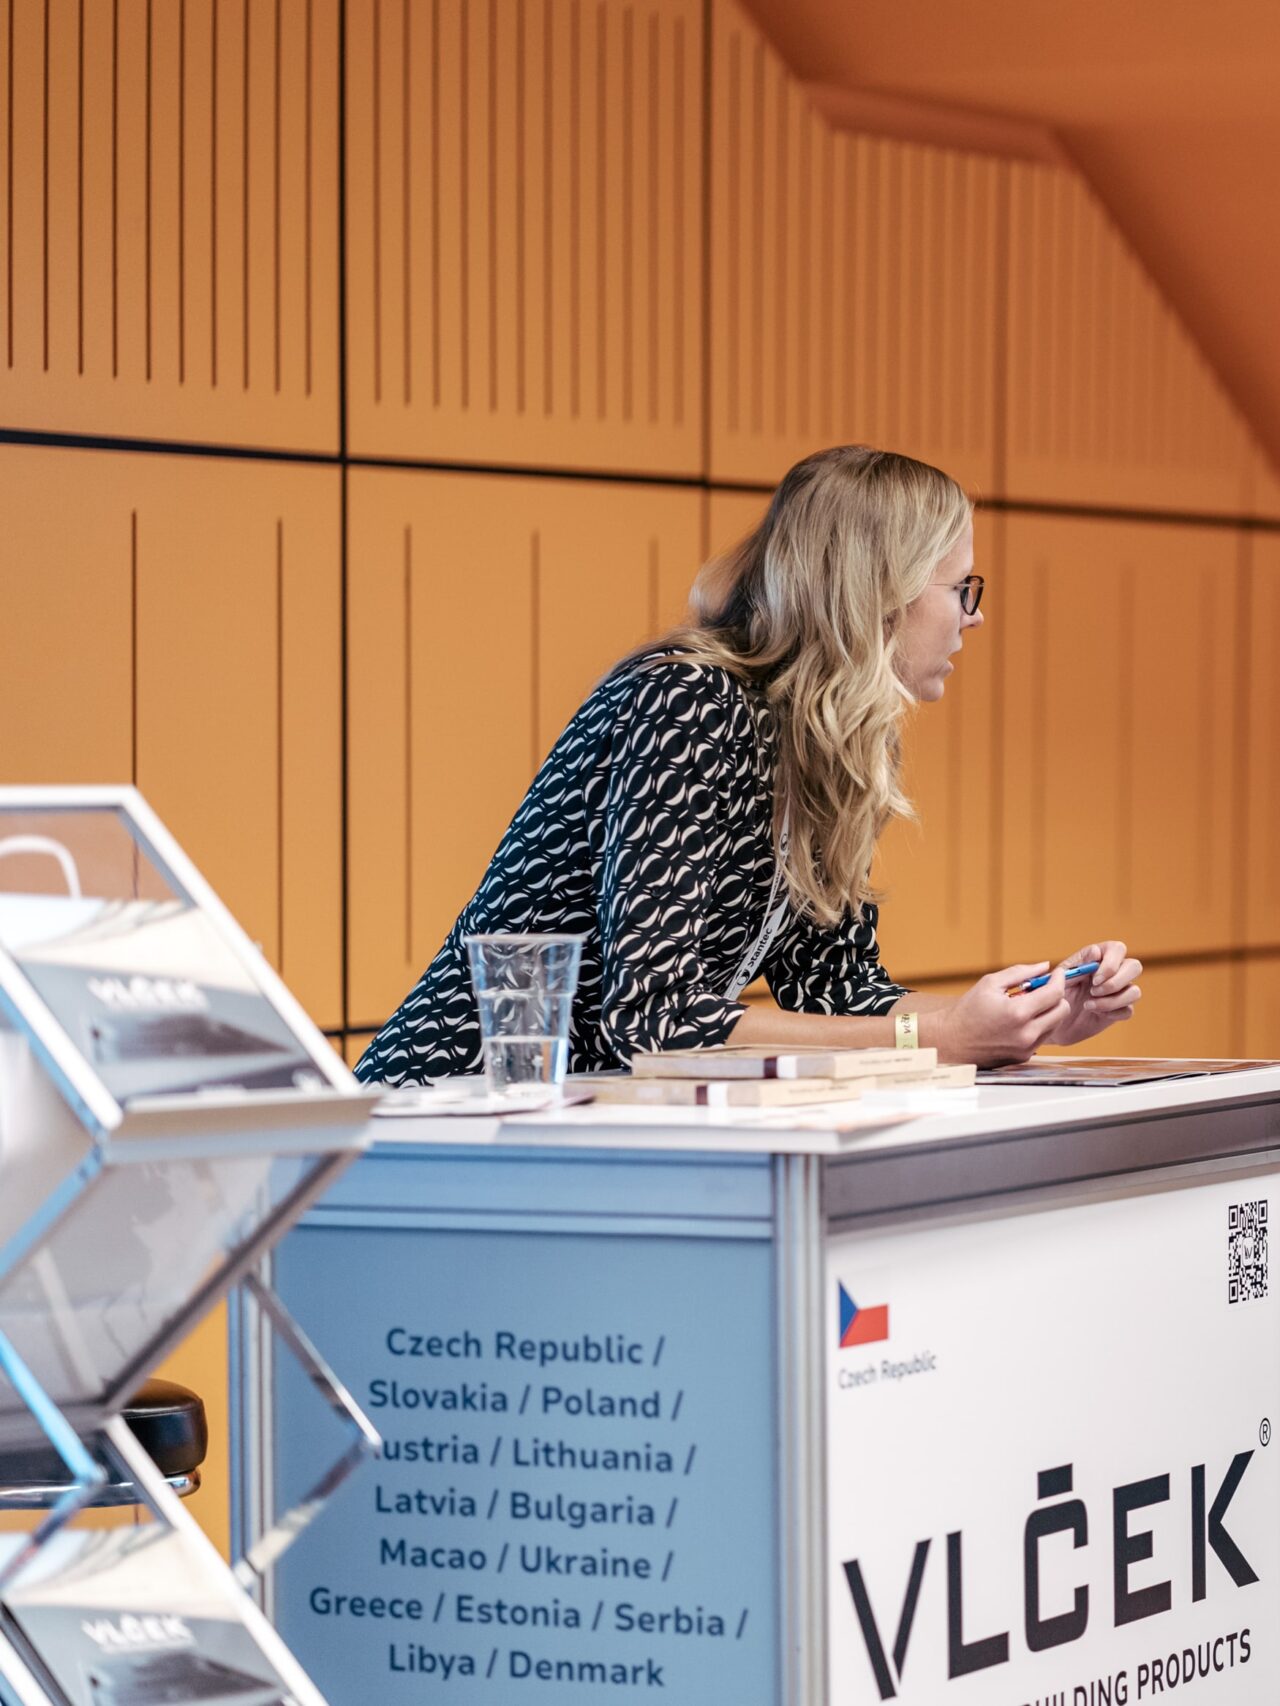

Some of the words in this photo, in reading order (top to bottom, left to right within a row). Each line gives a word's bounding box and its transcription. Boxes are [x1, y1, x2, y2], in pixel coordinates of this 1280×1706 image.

[386, 1327, 482, 1359] Czech
[495, 1331, 643, 1368] Republic
[652, 1335, 665, 1367] /
[838, 1364, 878, 1390] Czech
[881, 1350, 936, 1382] Republic
[368, 1379, 508, 1413] Slovakia
[518, 1384, 531, 1416] /
[542, 1385, 661, 1419] Poland
[671, 1390, 684, 1422] /
[375, 1434, 480, 1465] ustria
[489, 1436, 502, 1467] /
[513, 1437, 673, 1473] Lithuania
[683, 1444, 697, 1476] /
[375, 1485, 477, 1518] Latvia
[486, 1488, 499, 1520] /
[510, 1490, 655, 1529] Bulgaria
[665, 1497, 678, 1529] /
[380, 1538, 487, 1571] Macao
[496, 1542, 509, 1574] /
[519, 1544, 651, 1580] Ukraine
[661, 1551, 674, 1582] /
[842, 1449, 1260, 1701] VLČEK
[309, 1586, 423, 1621] Greece
[432, 1592, 445, 1623] /
[456, 1594, 581, 1630] Estonia
[591, 1601, 604, 1632] /
[614, 1602, 725, 1637] Serbia
[735, 1608, 749, 1640] /
[389, 1643, 475, 1681] Libya
[486, 1647, 499, 1679] /
[509, 1650, 665, 1687] Denmark
[1137, 1628, 1252, 1700] PRODUCTS
